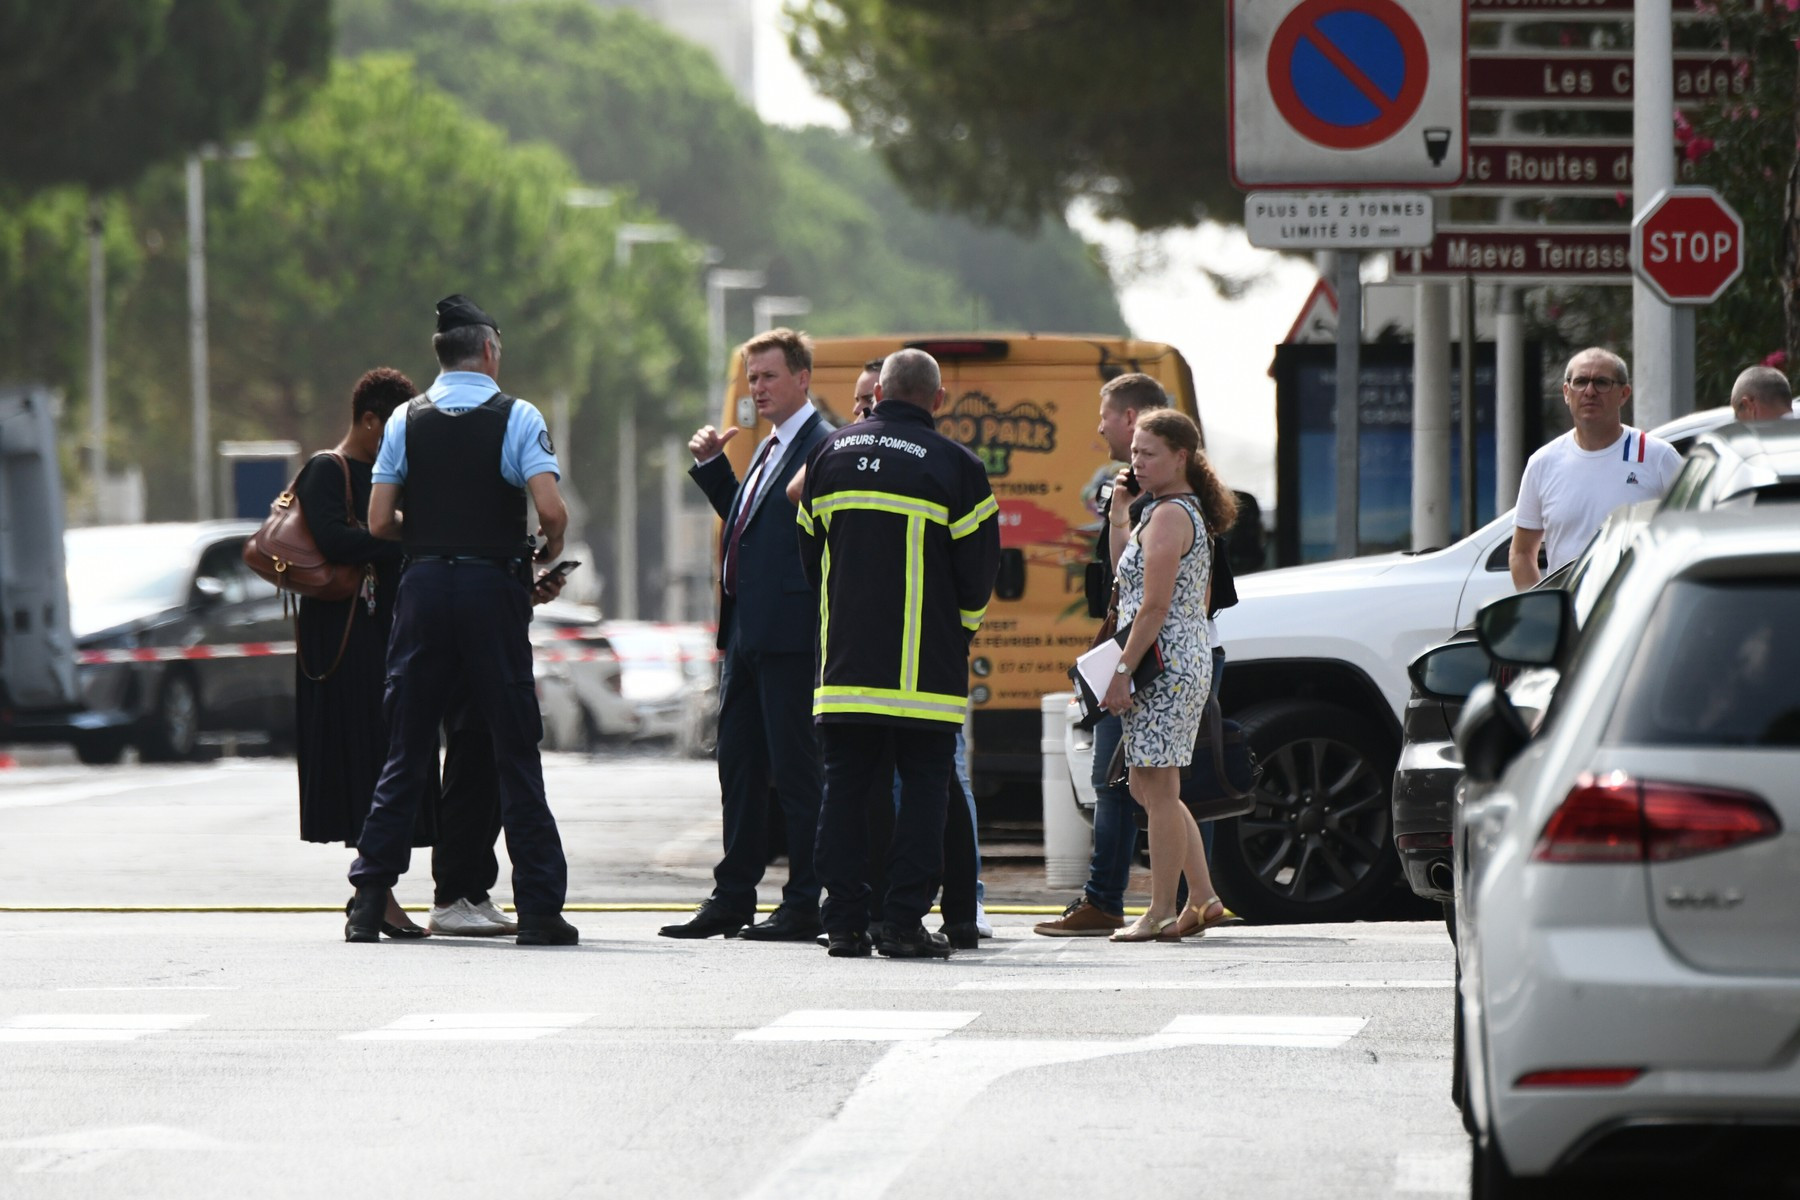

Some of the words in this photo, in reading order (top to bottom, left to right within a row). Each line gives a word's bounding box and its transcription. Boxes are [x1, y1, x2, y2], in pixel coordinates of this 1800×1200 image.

[1544, 65, 1593, 93] Les
[1611, 65, 1746, 94] Cades
[1467, 156, 1491, 180] tc
[1506, 151, 1597, 180] Routes
[1256, 204, 1298, 218] PLUS
[1308, 204, 1329, 217] DE
[1339, 205, 1349, 217] 2
[1359, 203, 1425, 217] TONNES
[1281, 223, 1339, 238] LIMITÉ
[1350, 226, 1370, 238] 30
[1447, 239, 1526, 268] Maeva
[1650, 232, 1732, 263] STOP
[833, 434, 928, 459] SAPEURS-POMPIERS
[981, 418, 1053, 449] PARK
[857, 457, 880, 472] 34
